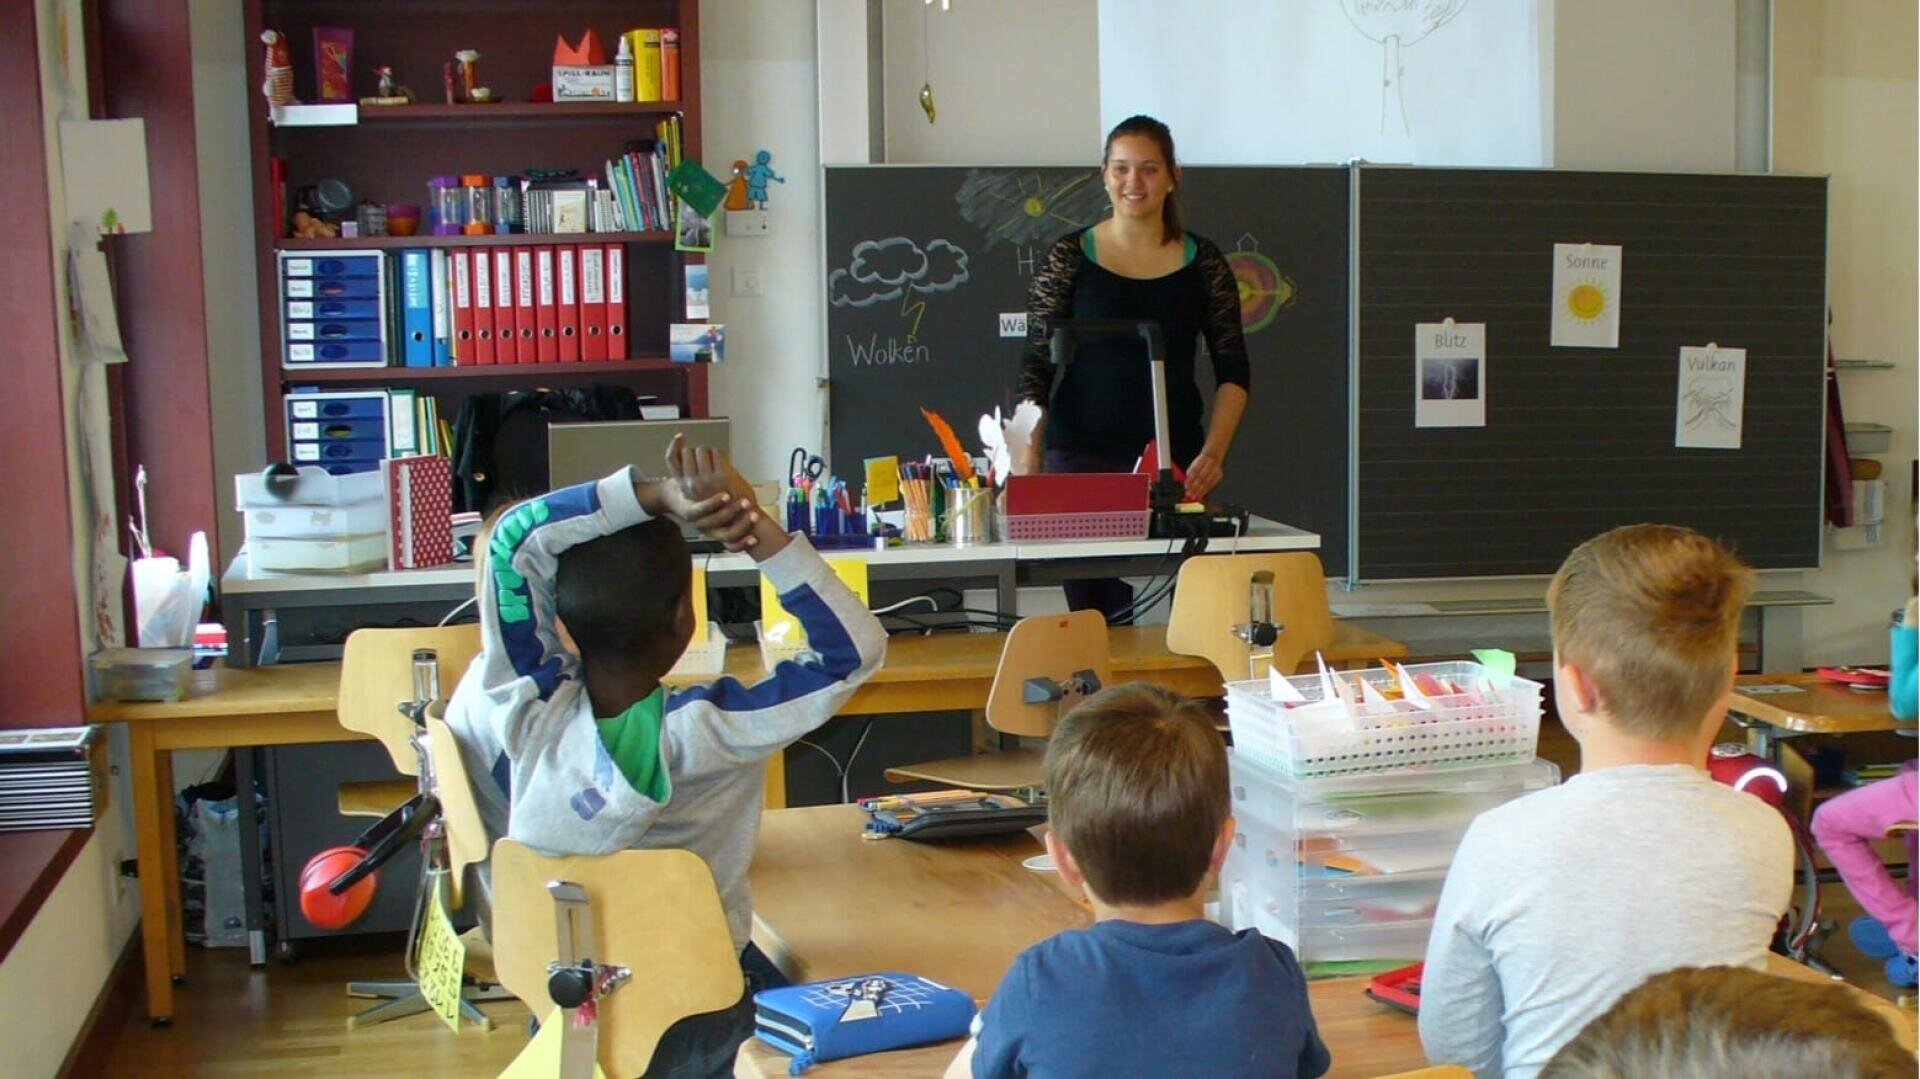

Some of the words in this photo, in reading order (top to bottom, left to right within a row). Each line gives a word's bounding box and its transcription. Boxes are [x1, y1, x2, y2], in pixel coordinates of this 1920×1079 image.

[1566, 253, 1609, 270] Sonne
[1434, 331, 1468, 349] Blitz
[845, 333, 929, 367] Wolken
[1687, 355, 1737, 371] Vulkan
